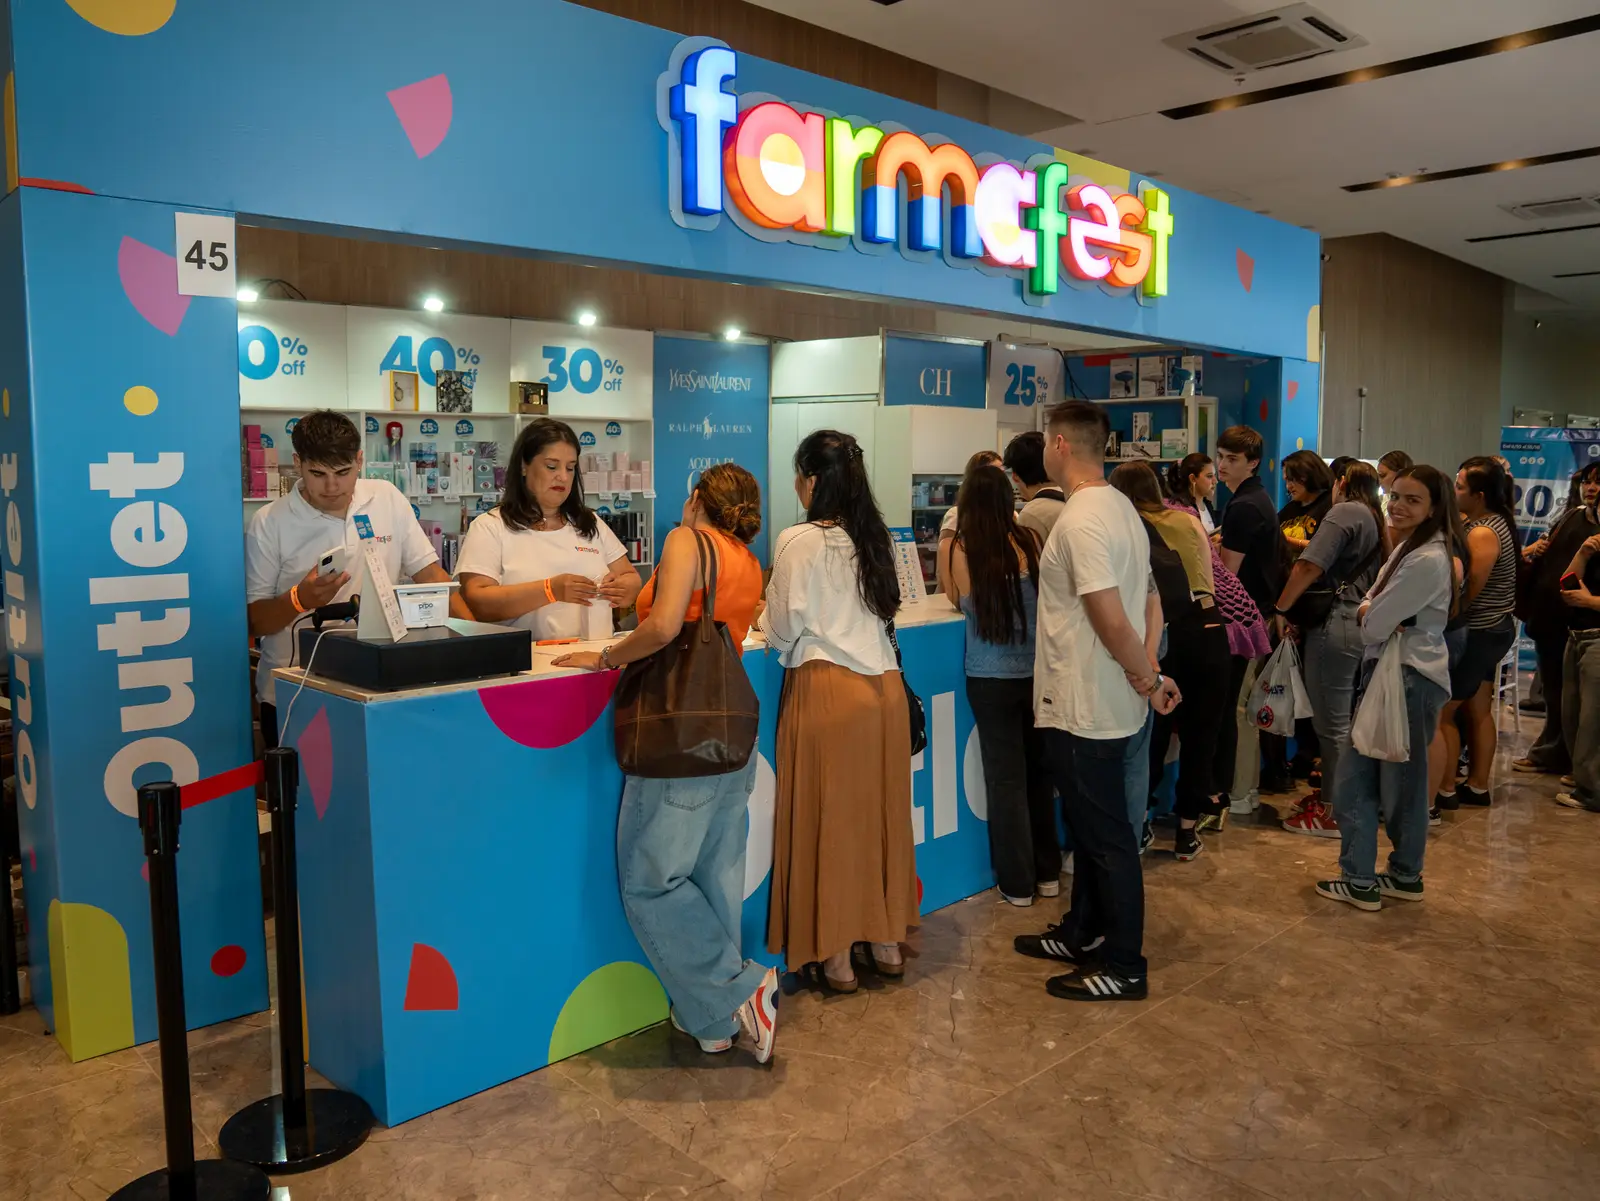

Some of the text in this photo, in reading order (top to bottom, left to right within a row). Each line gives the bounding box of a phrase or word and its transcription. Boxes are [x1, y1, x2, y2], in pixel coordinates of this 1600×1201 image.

[669, 46, 1174, 298] farmafest
[185, 239, 229, 272] 45
[281, 360, 306, 375] off
[919, 367, 952, 396] CH
[603, 378, 622, 391] off
[1036, 392, 1047, 404] off
[668, 423, 752, 434] RALPH LAUREN
[0, 452, 37, 810] outlet
[89, 451, 200, 819] outlet
